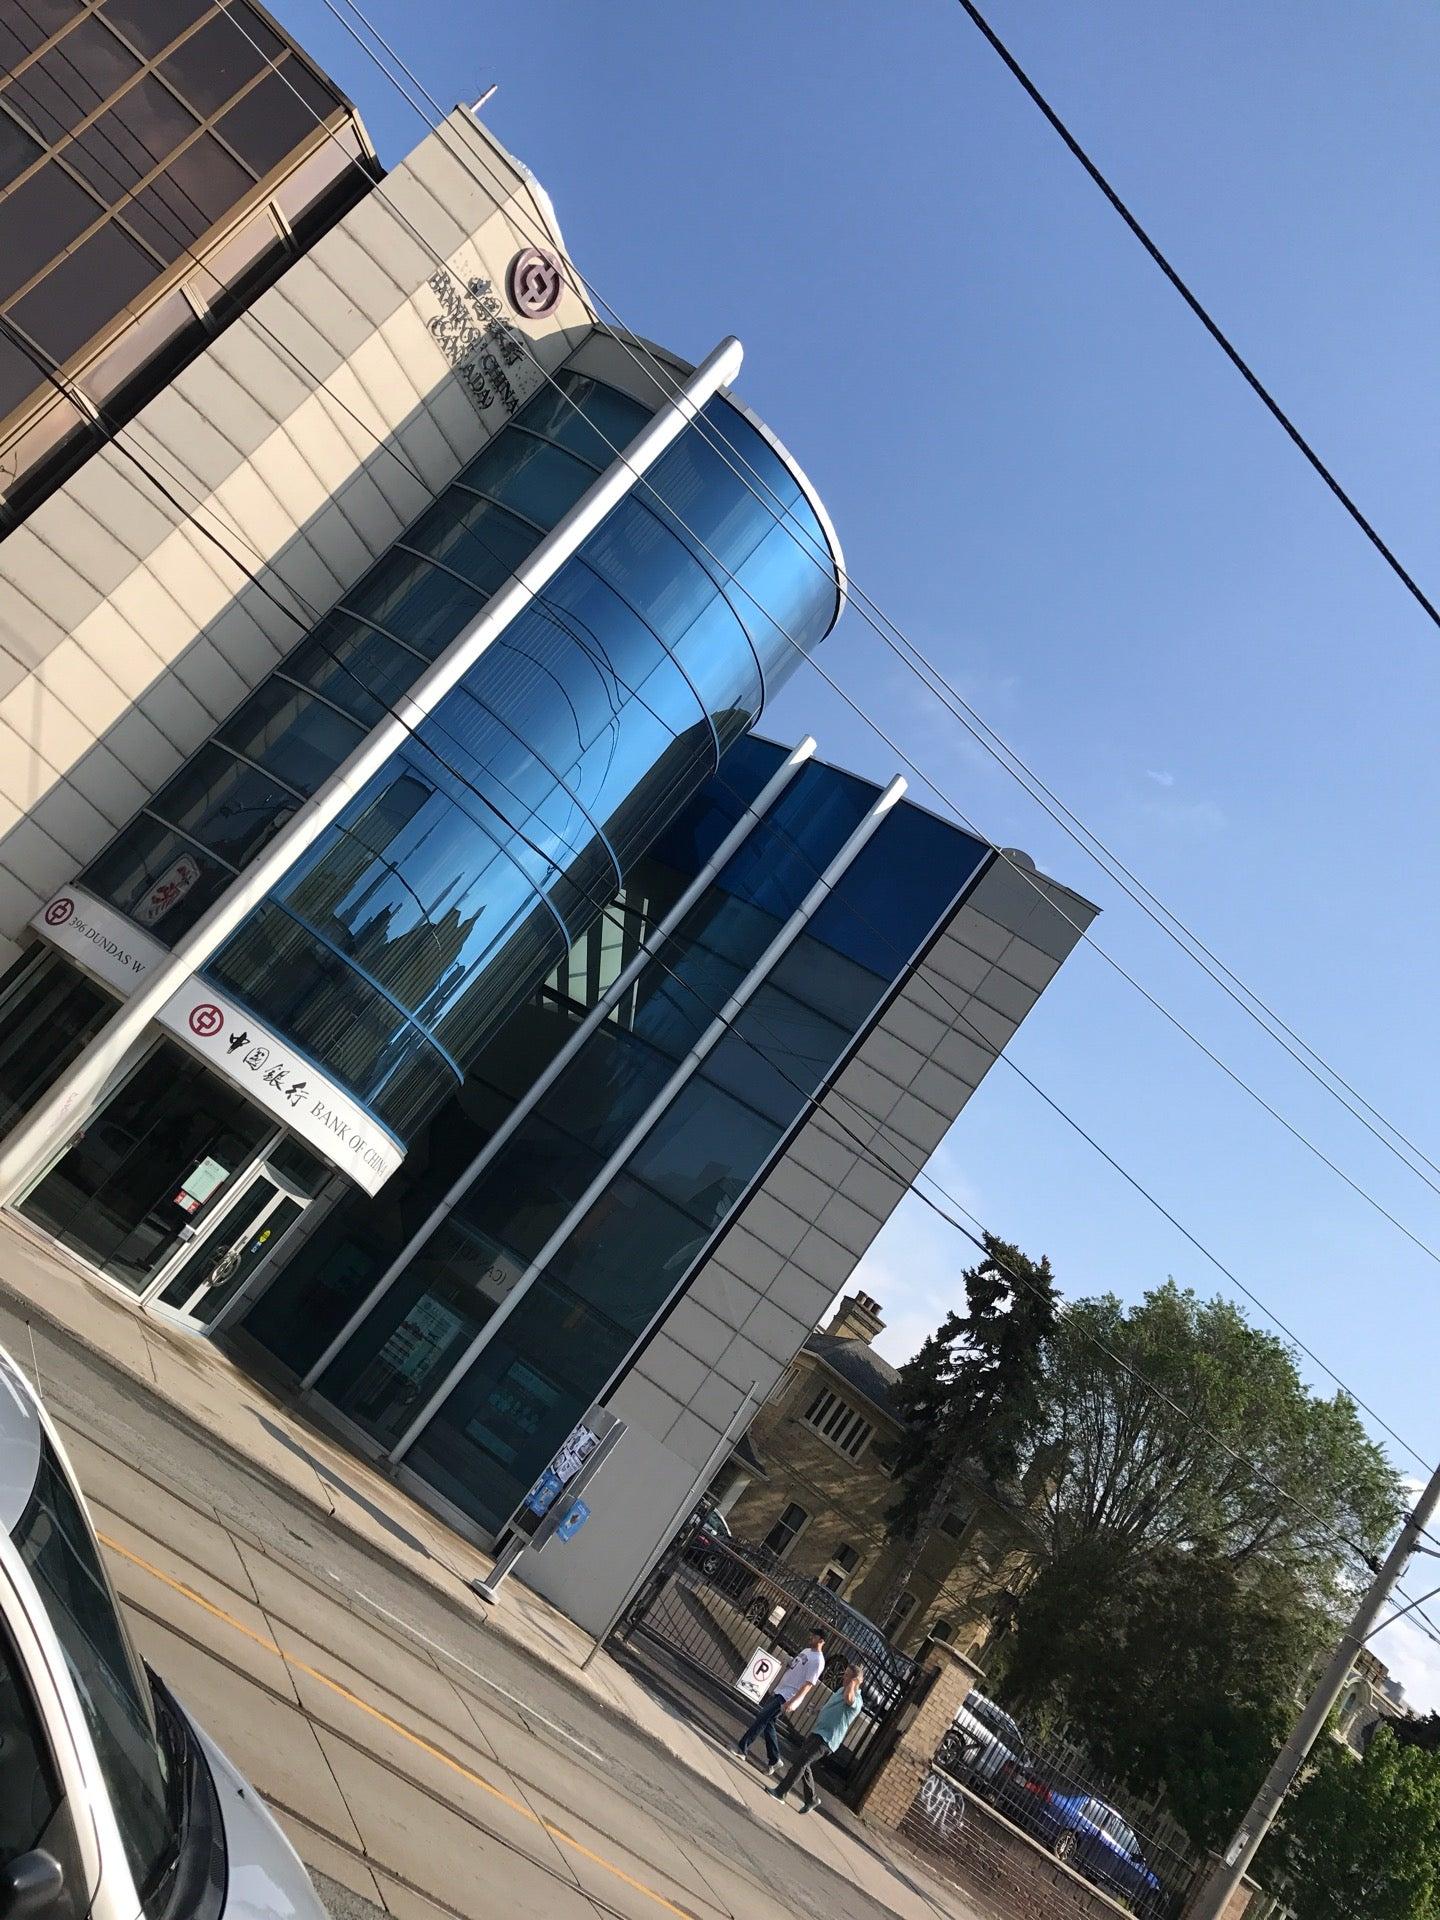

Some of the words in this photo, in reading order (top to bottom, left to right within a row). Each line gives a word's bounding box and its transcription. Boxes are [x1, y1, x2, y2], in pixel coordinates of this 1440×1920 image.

[427, 270, 471, 322] BANK
[481, 353, 520, 414] CHINA
[69, 917, 87, 933] 396
[85, 928, 132, 965] DUNDAS
[131, 960, 146, 973] W
[310, 1100, 351, 1141] BANK
[348, 1134, 367, 1153] OF
[363, 1148, 389, 1177] CHINA
